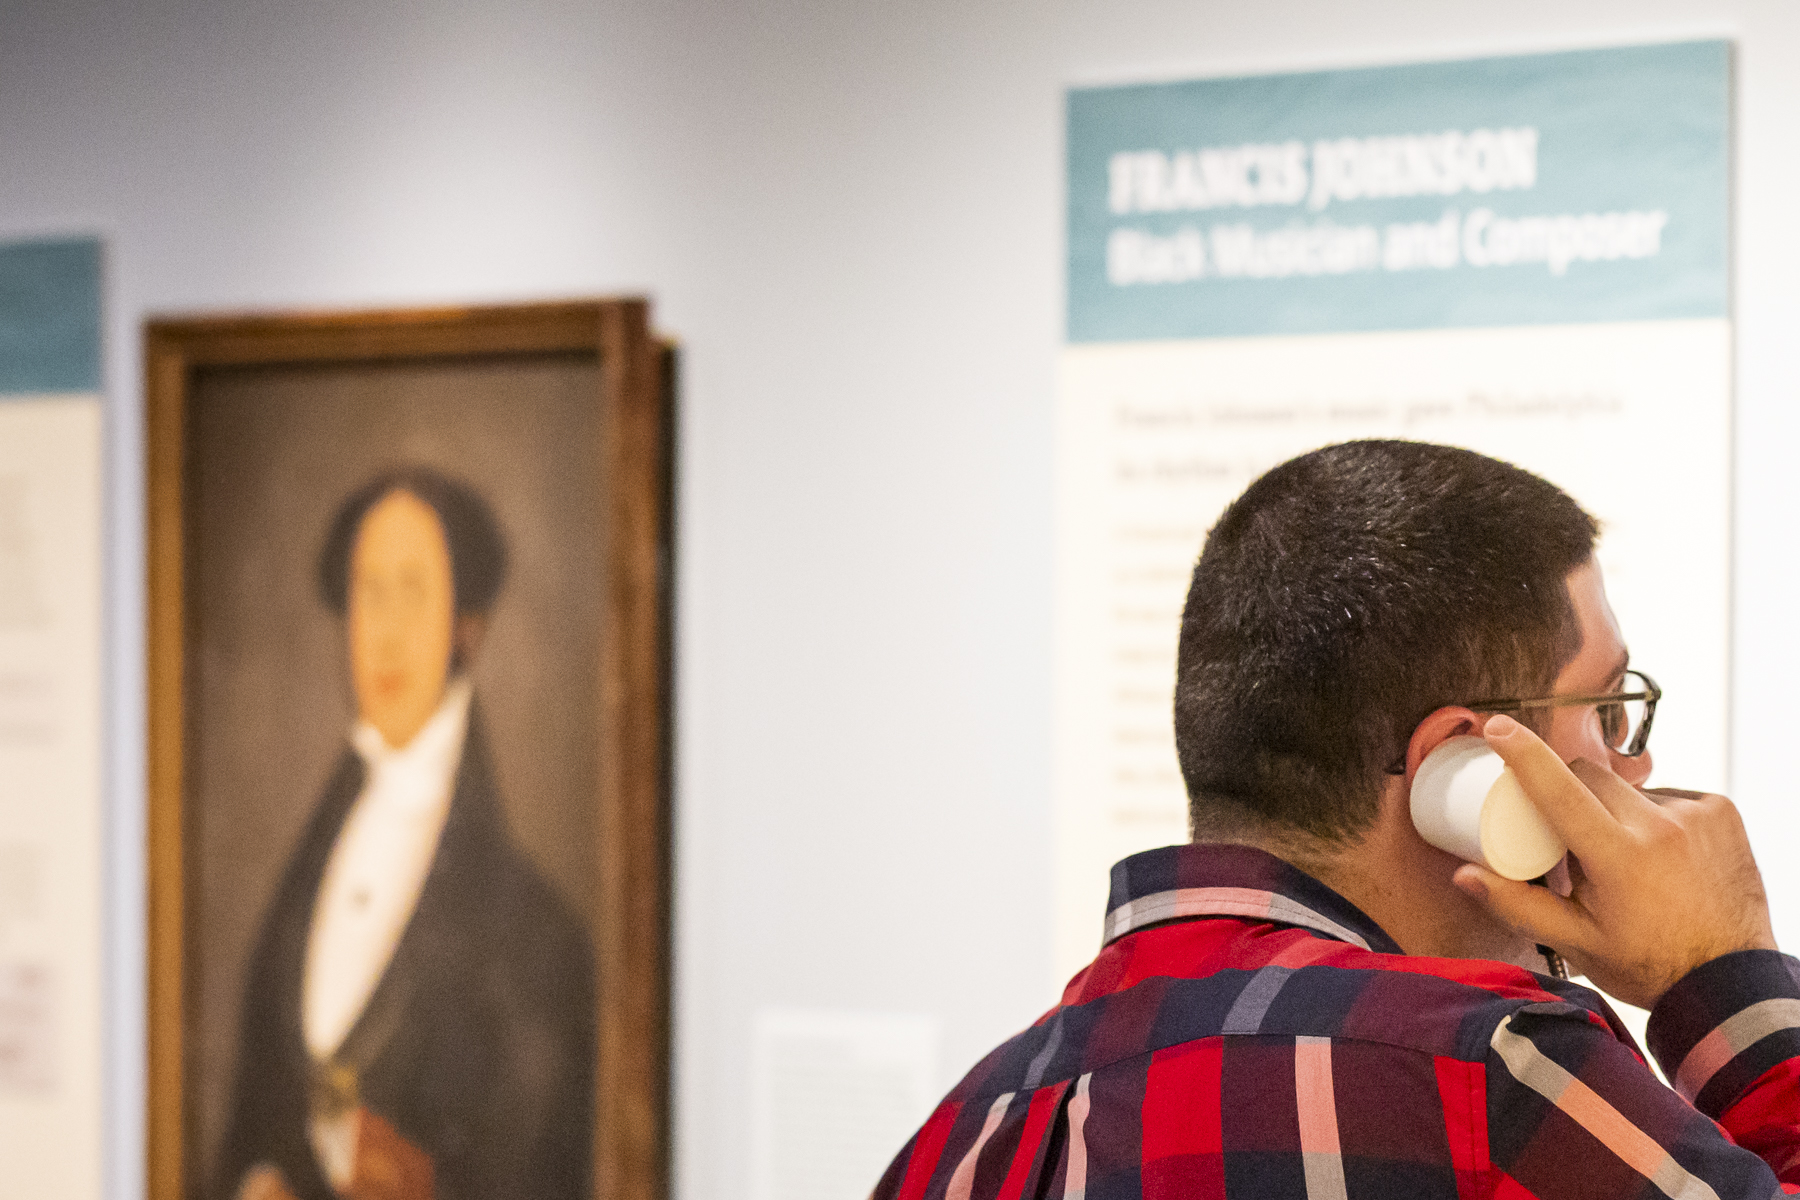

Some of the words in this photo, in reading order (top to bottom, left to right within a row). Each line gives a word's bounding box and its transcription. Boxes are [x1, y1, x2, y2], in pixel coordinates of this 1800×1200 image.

[1108, 139, 1309, 215] FRANCIS
[1310, 126, 1538, 212] JOHNSON
[1108, 225, 1204, 286] Black
[1208, 221, 1380, 281] Musician
[1383, 208, 1461, 272] and
[1463, 206, 1667, 278] Composer
